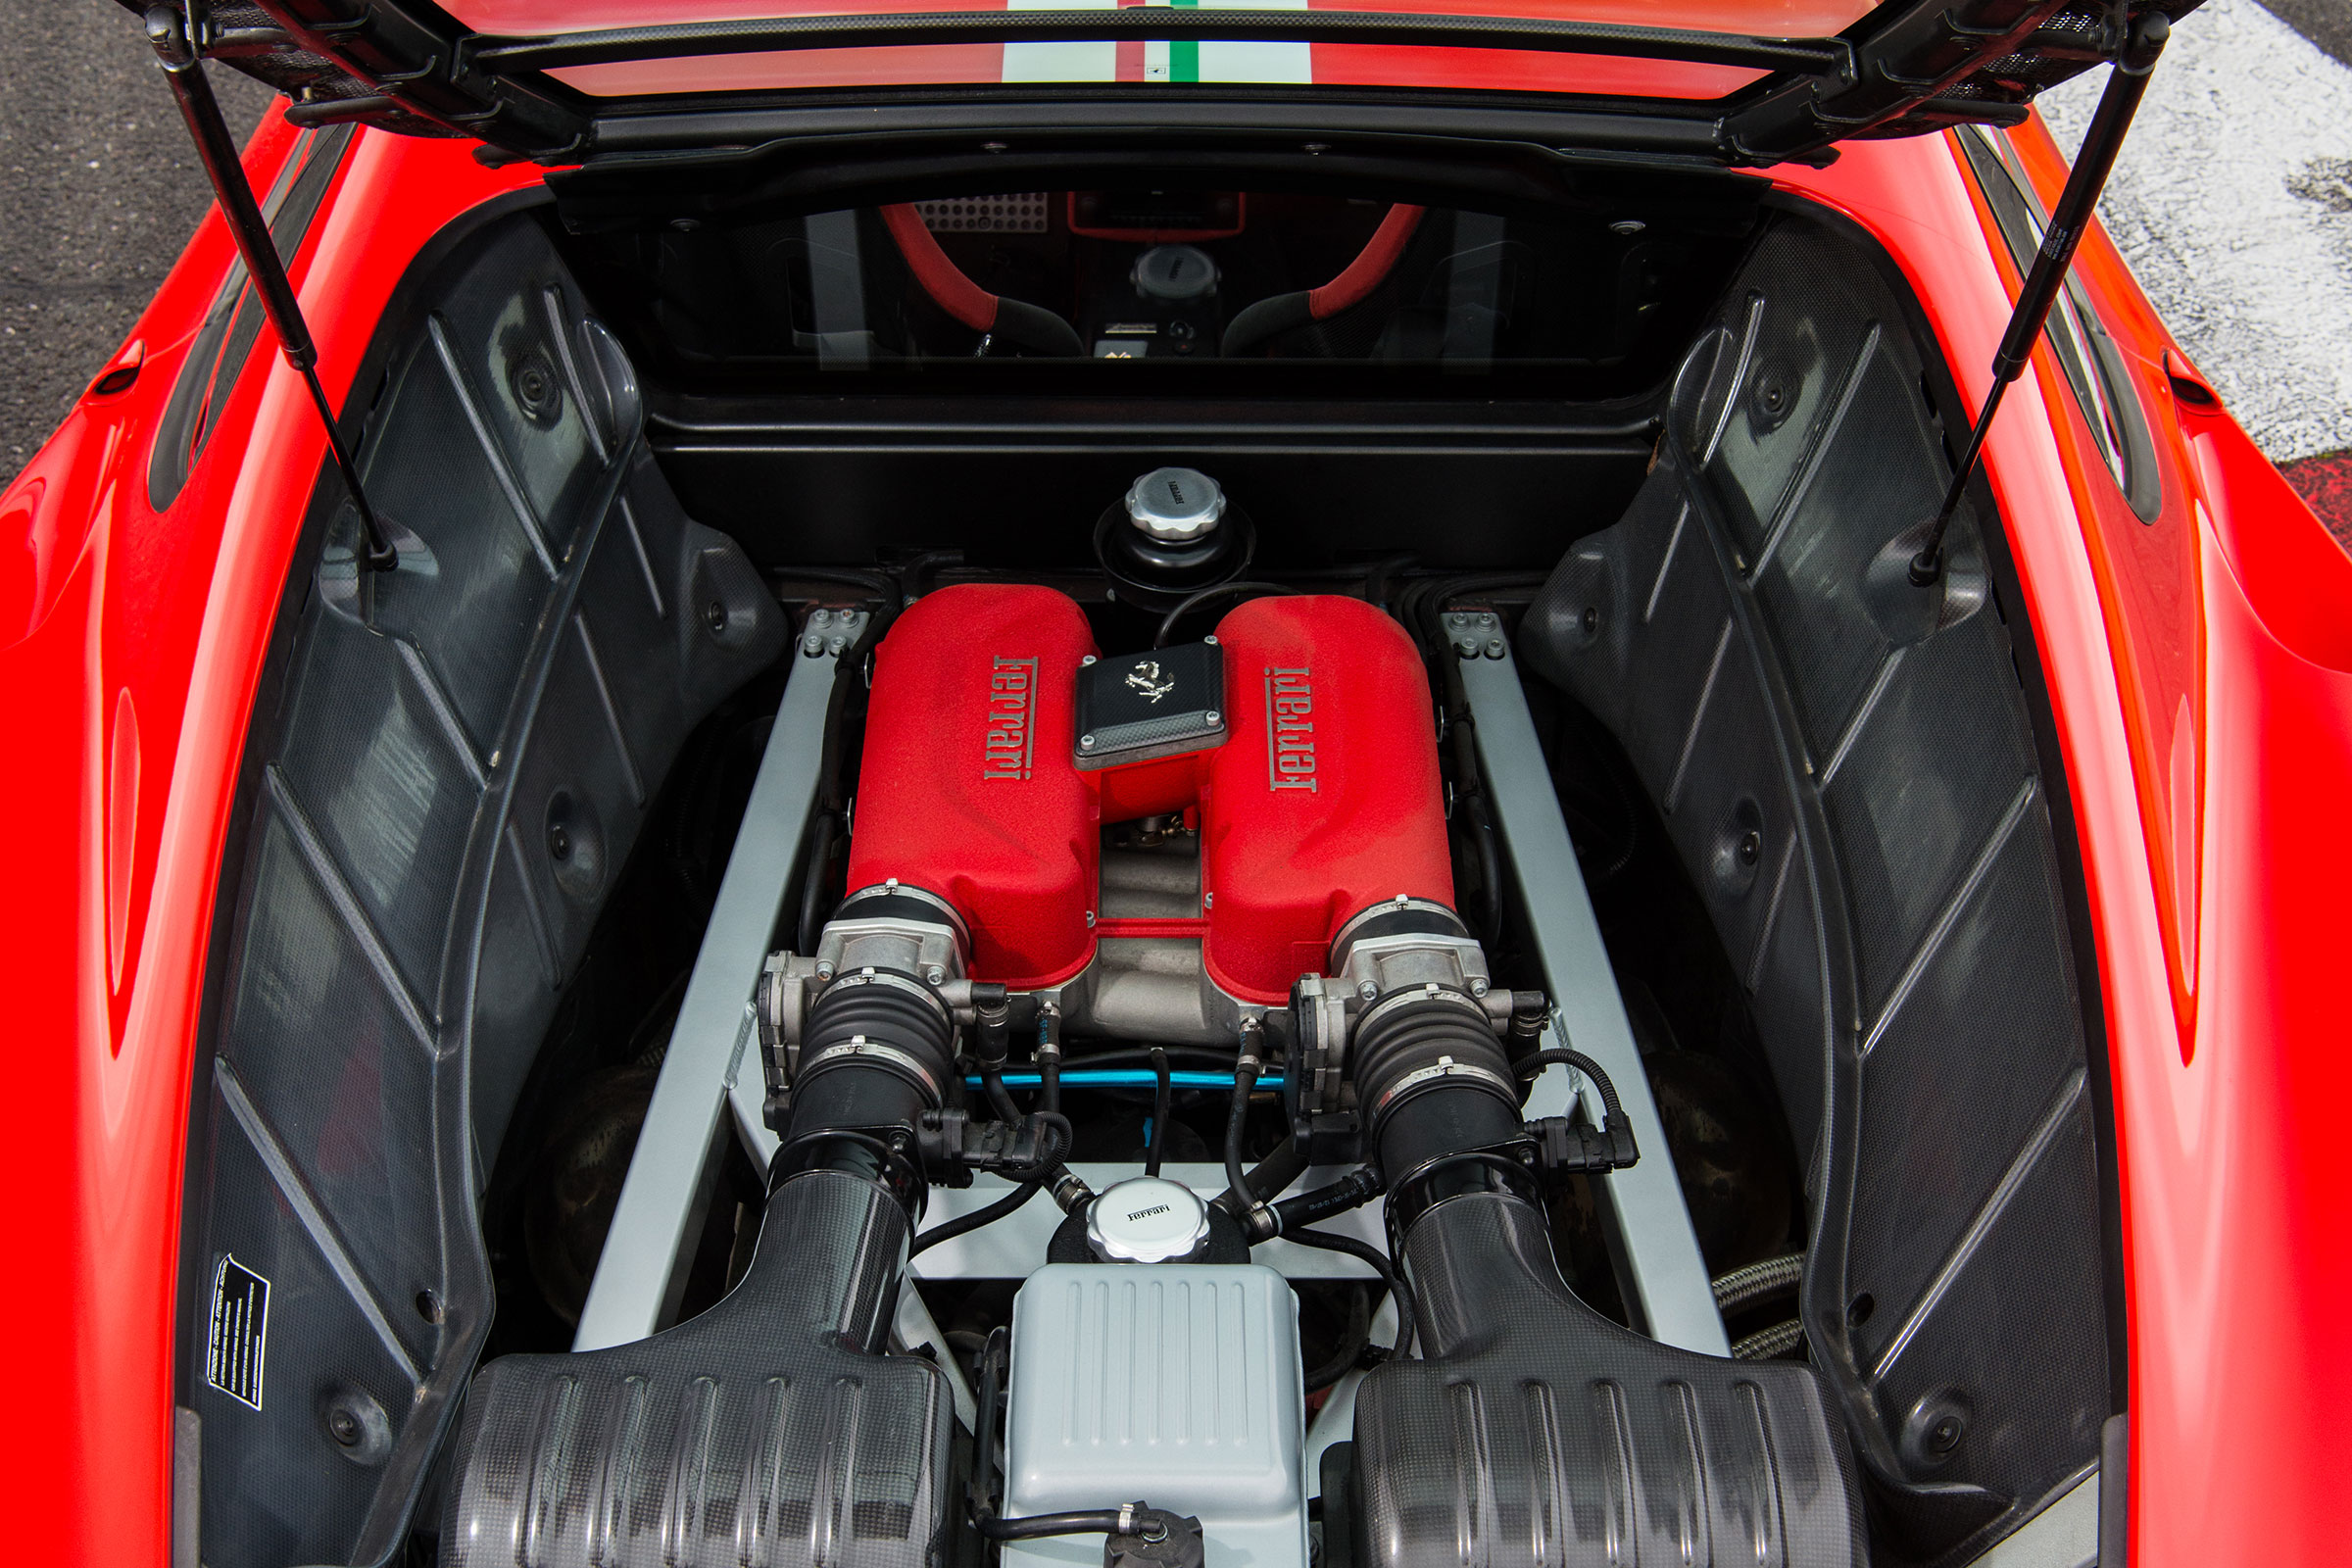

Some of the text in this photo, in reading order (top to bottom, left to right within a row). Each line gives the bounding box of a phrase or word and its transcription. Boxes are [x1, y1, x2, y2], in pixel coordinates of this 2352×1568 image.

[984, 655, 1039, 780] Ferrari
[1264, 666, 1317, 793] Ferrari
[1127, 1203, 1170, 1222] Ferrari
